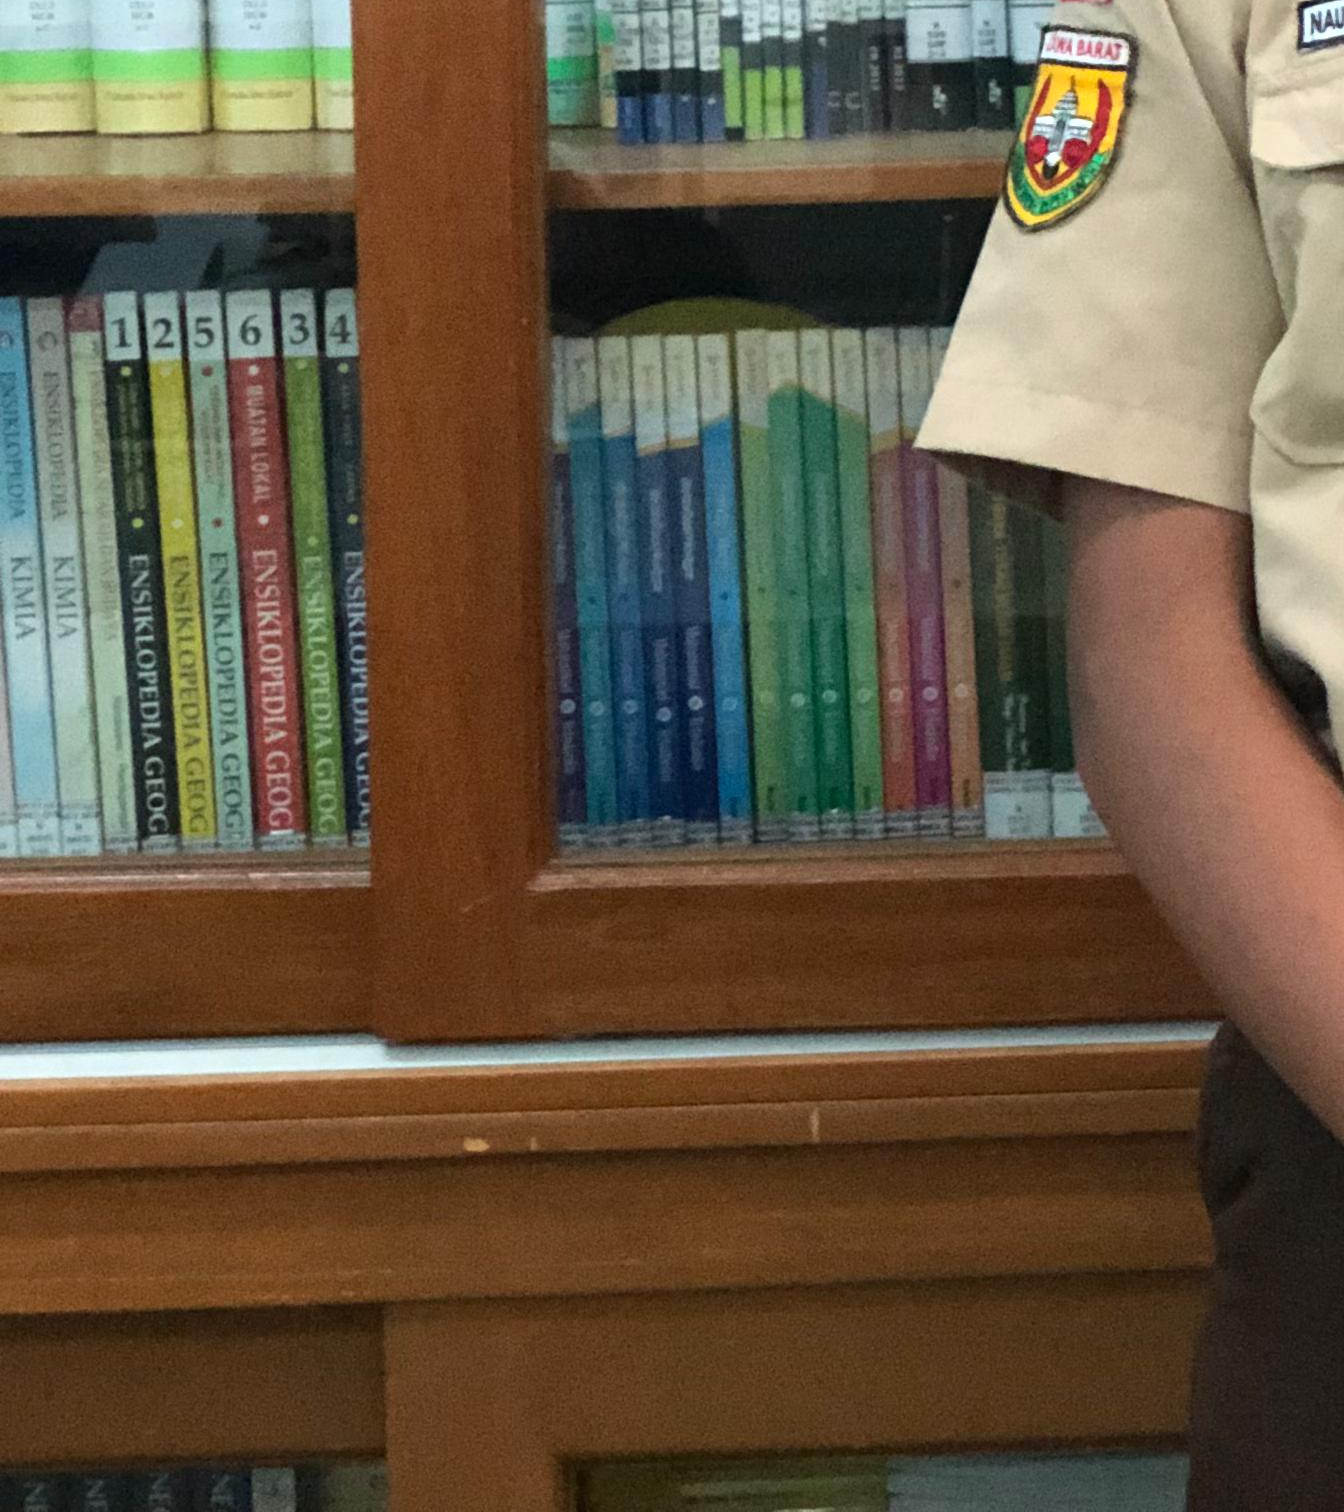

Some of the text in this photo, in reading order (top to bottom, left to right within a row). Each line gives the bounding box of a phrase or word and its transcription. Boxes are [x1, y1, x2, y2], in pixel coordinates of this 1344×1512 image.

[1076, 38, 1123, 62] BARAT
[111, 317, 133, 348] 1
[153, 318, 176, 350] 2
[195, 316, 215, 347] 5
[240, 314, 262, 346] 6
[288, 313, 310, 345] 3
[328, 312, 354, 345] 4
[42, 370, 81, 641] ENSIKLOPEDIA KIMIA
[250, 452, 269, 504] LOKAL
[10, 555, 37, 641] KIMIA
[128, 554, 160, 749] ENSIKLOPEDIA
[168, 554, 199, 751] ENSIKLOPEDIA
[208, 552, 239, 746] ENSIKLOPEDIA
[252, 549, 289, 743] ENSIKLOPEDIA
[300, 554, 331, 751] ENSIKLOPEDIA
[342, 551, 367, 746] ENSIKLOPEDIA
